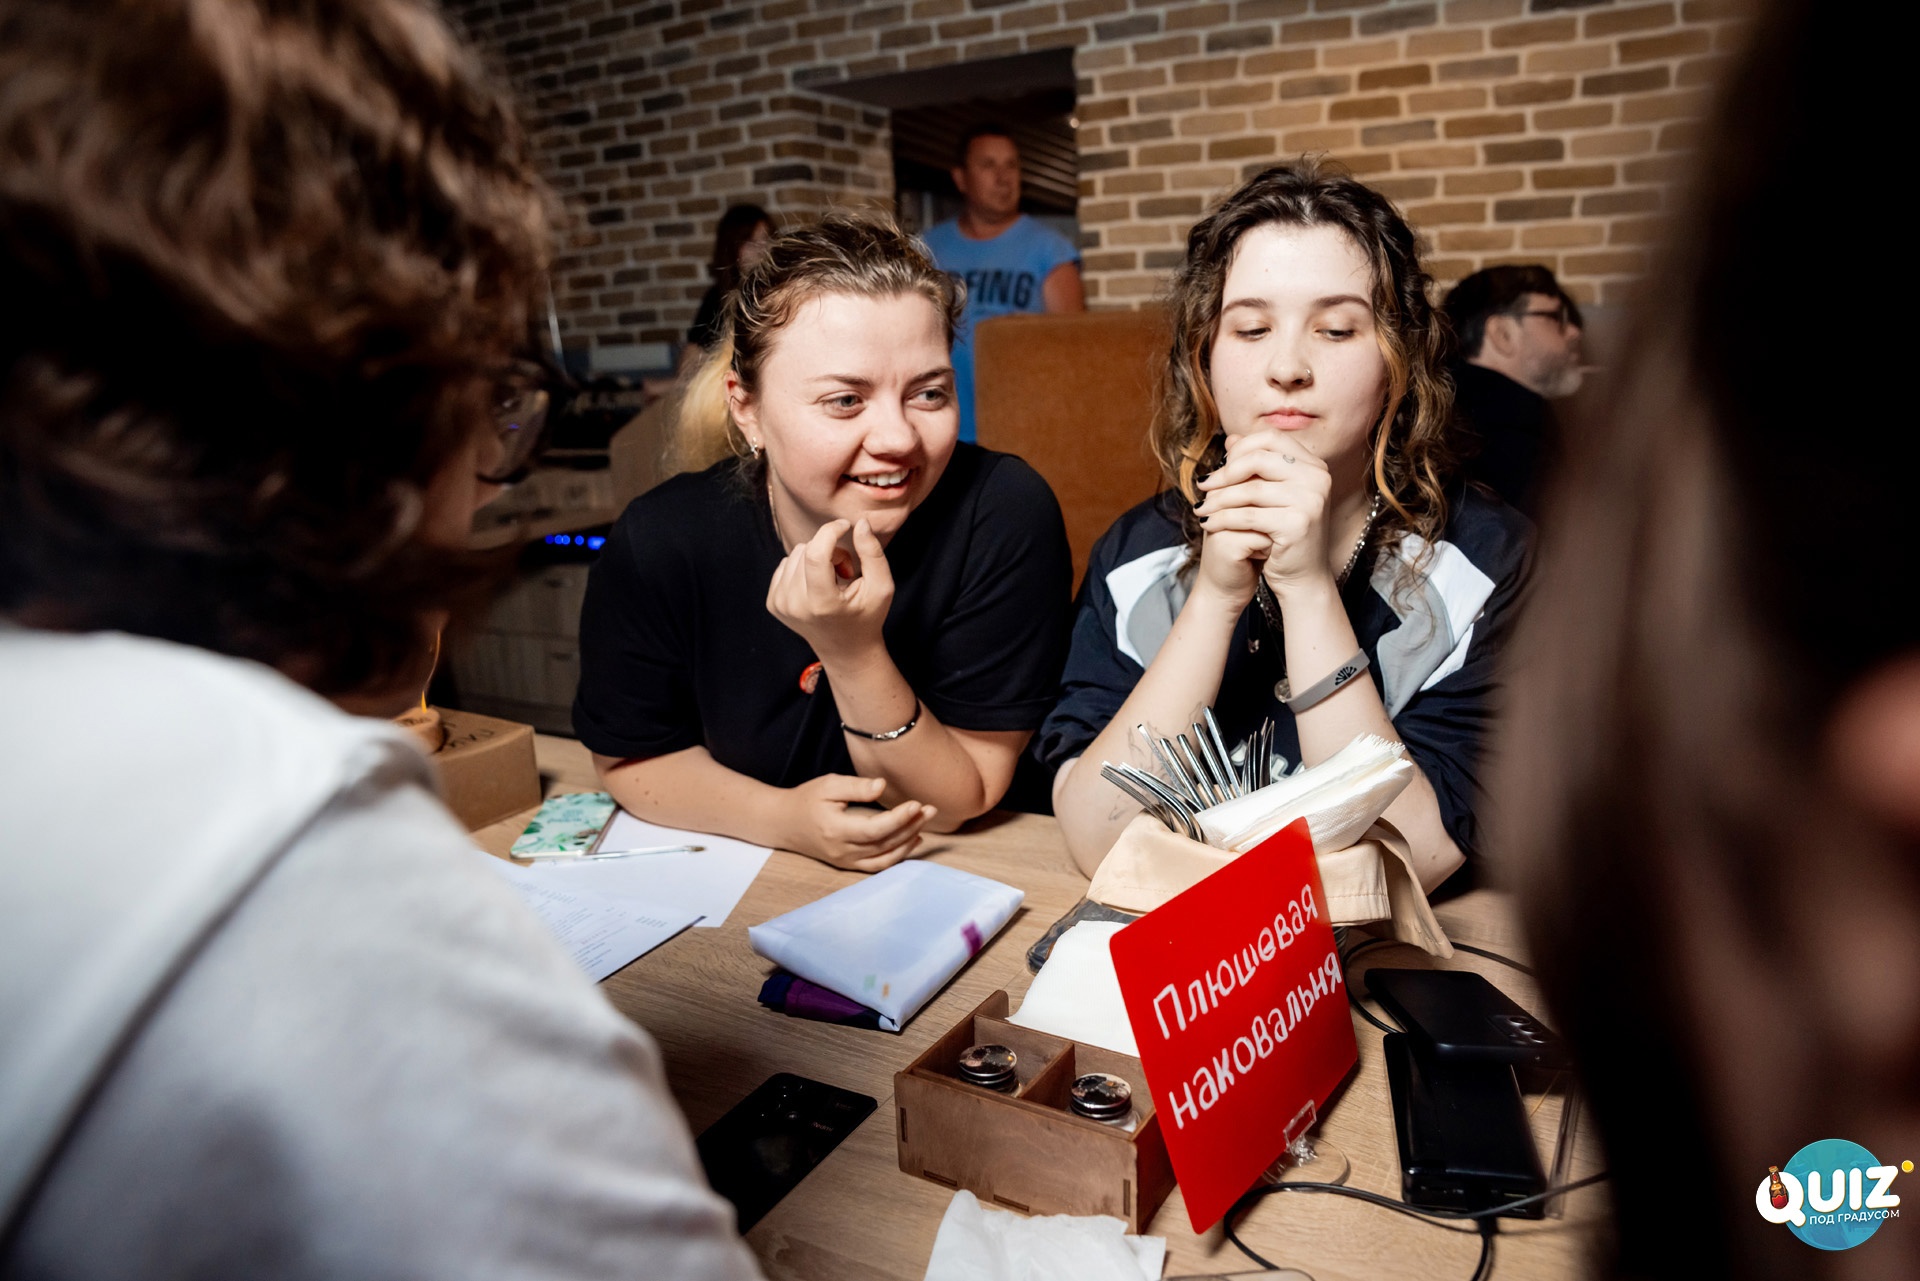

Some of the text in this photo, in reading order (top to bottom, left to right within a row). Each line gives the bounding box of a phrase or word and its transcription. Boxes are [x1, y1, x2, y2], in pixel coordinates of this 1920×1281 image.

[952, 269, 1034, 308] FING
[1153, 883, 1319, 1040] Плюшевая
[1168, 952, 1343, 1129] наковальня
